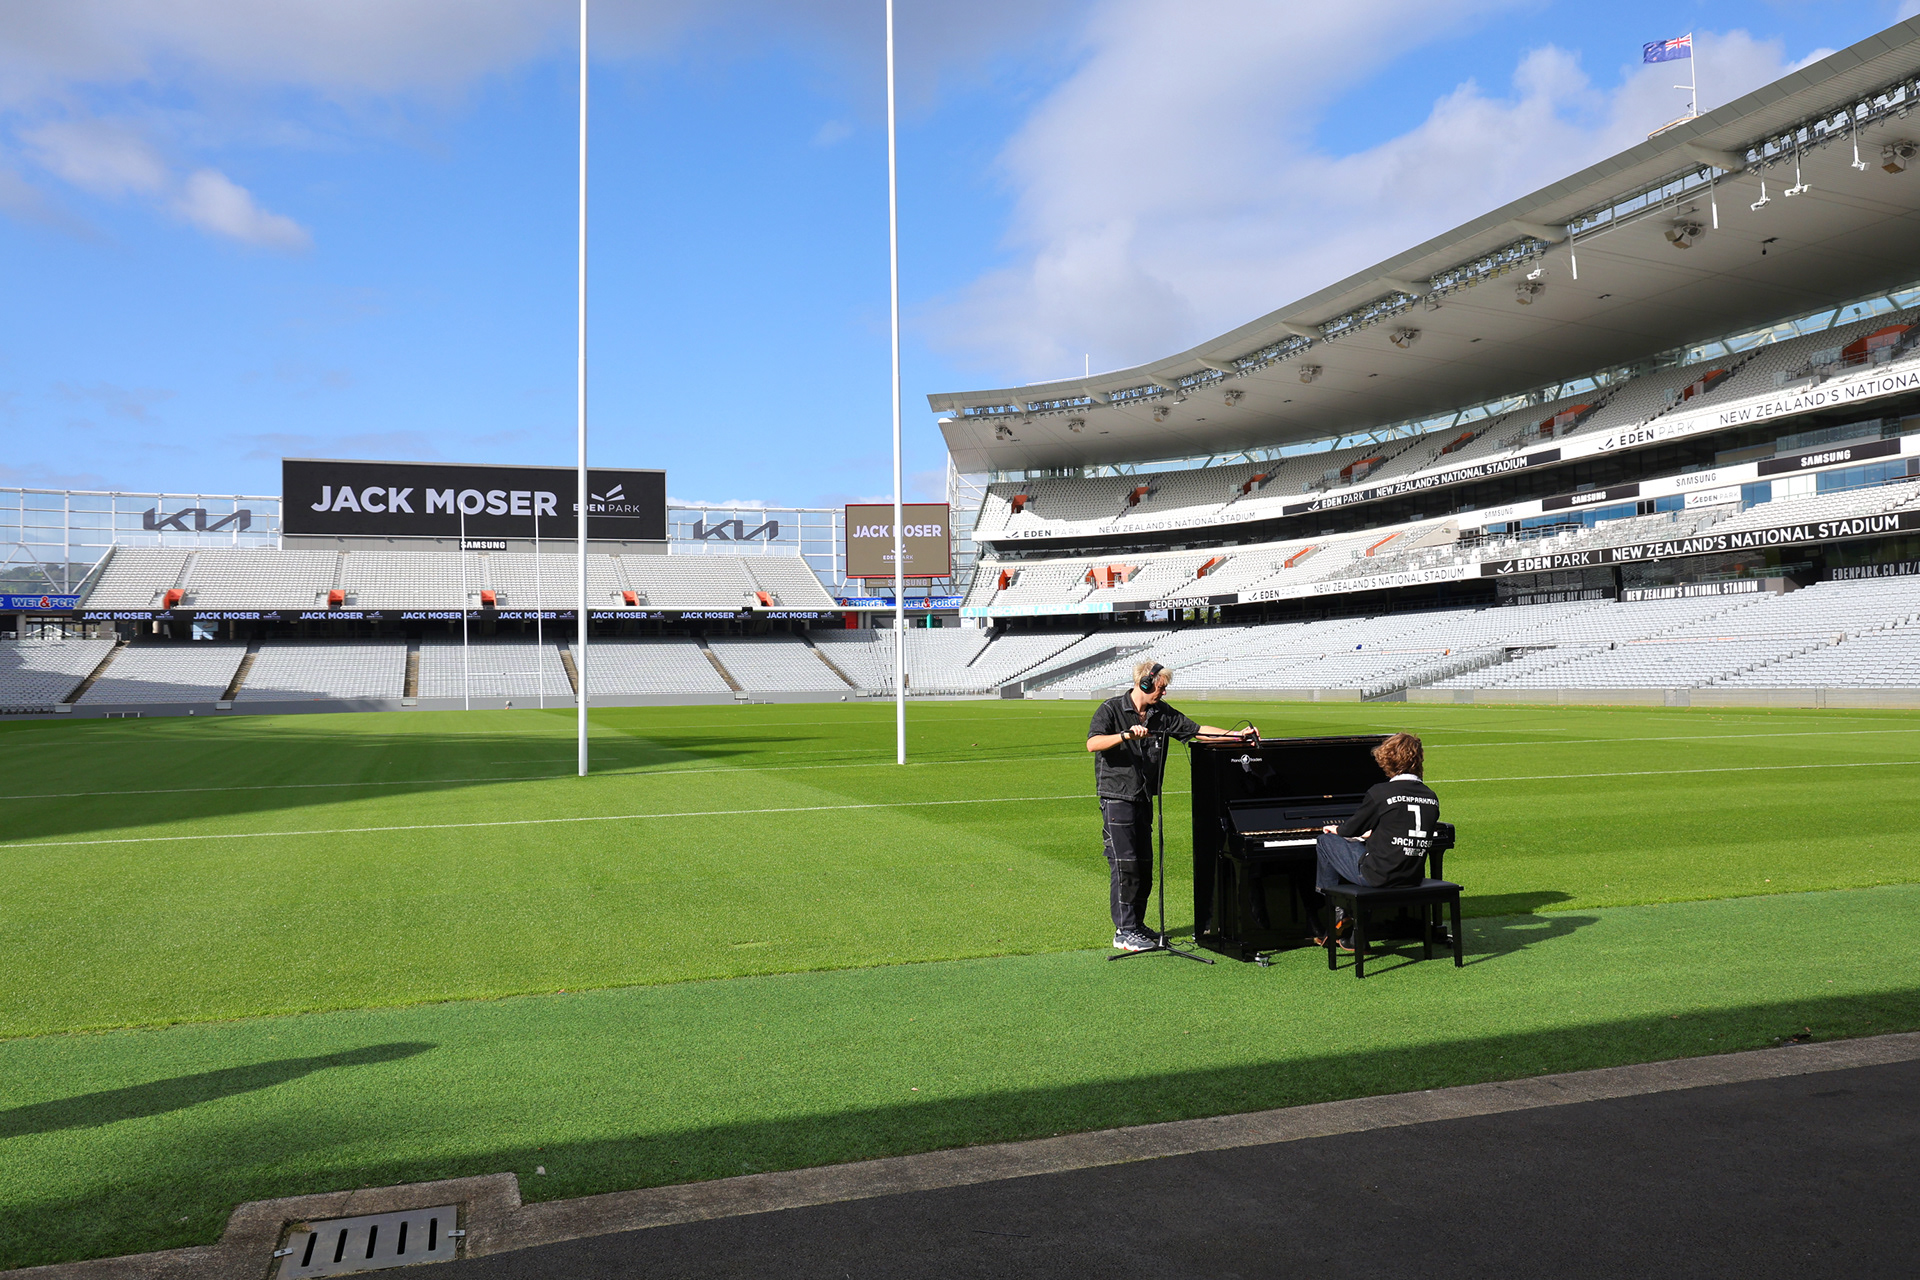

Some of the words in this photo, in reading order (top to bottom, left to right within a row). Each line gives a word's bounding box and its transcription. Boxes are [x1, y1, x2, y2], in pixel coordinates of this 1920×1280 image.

[1620, 429, 1654, 446] EDEN
[1658, 421, 1695, 438] PARK
[1720, 408, 1751, 425] NEW
[1756, 389, 1839, 418] ZEALAND'S
[1845, 372, 1920, 398] NATIONA
[1801, 449, 1851, 467] SAMSUNG
[1322, 497, 1342, 508] EDEN
[1343, 491, 1364, 503] PARK
[1376, 485, 1393, 497] NEW
[1396, 476, 1439, 493] ZEALAND'S
[1441, 466, 1485, 483] NATIONAL
[1487, 456, 1528, 474] STADIUM
[1676, 473, 1717, 487] SAMSUNG
[310, 485, 415, 514] JACK
[425, 488, 558, 517] MOSER
[1571, 491, 1607, 505] SAMSUNG
[1700, 495, 1718, 503] EDEN
[573, 503, 605, 512] EEN
[608, 504, 640, 513] PARK
[1484, 507, 1514, 518] SAMSUNG
[852, 525, 890, 538] JACK
[893, 524, 942, 537] OSER
[1023, 529, 1052, 538] EDEN
[1099, 525, 1120, 534] NEW
[1123, 520, 1173, 533] ZEALAND'S
[1175, 516, 1218, 529] NATIONAL
[1220, 512, 1256, 524] STADIUM
[1517, 556, 1551, 572] EDEN
[1555, 552, 1590, 567] PARK
[1612, 545, 1643, 561] NEW
[1646, 535, 1727, 557] ZEALAND'S
[1731, 525, 1815, 548] NATIONAL
[1818, 514, 1900, 538] STADIUM
[1260, 589, 1280, 599] EDEN
[1313, 583, 1331, 593] NEW
[1333, 578, 1377, 592] ZEALAND'S
[1378, 573, 1421, 586] NATIONAL
[1424, 567, 1465, 581] STADIUM
[1579, 588, 1603, 600] LOUNGE
[1626, 590, 1642, 601] NEW
[1644, 587, 1683, 600] ZEALAND'S
[1684, 583, 1721, 598] NATIONAL
[1723, 580, 1758, 594] STADIUM
[1149, 597, 1210, 609] @EDENPARKNZ
[82, 612, 111, 620] JACK
[113, 612, 152, 620] MOSER
[193, 612, 221, 620] JACK
[223, 612, 260, 620] MOSER
[299, 612, 327, 620] JACK
[328, 612, 364, 620] MOSER
[401, 612, 426, 620] JACK
[428, 612, 462, 620] MOSER
[1407, 804, 1427, 838] 1
[1391, 837, 1414, 847] JACK
